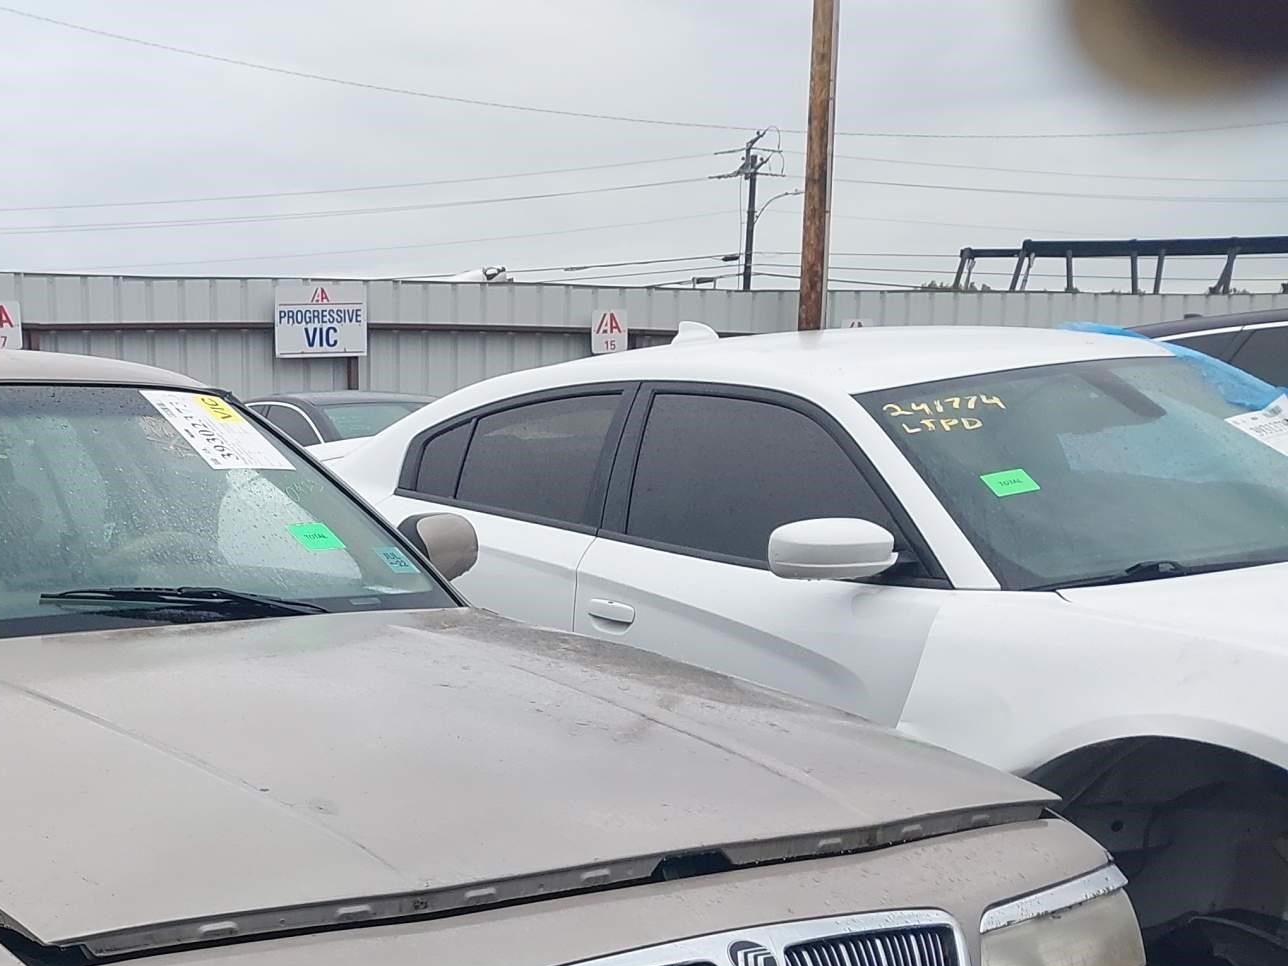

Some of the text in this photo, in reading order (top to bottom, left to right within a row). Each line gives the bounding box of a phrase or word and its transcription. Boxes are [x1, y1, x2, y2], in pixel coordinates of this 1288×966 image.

[278, 308, 362, 325] PROGRESSIVE
[304, 326, 338, 348] VIC
[604, 340, 617, 351] 15
[200, 397, 233, 419] VIC
